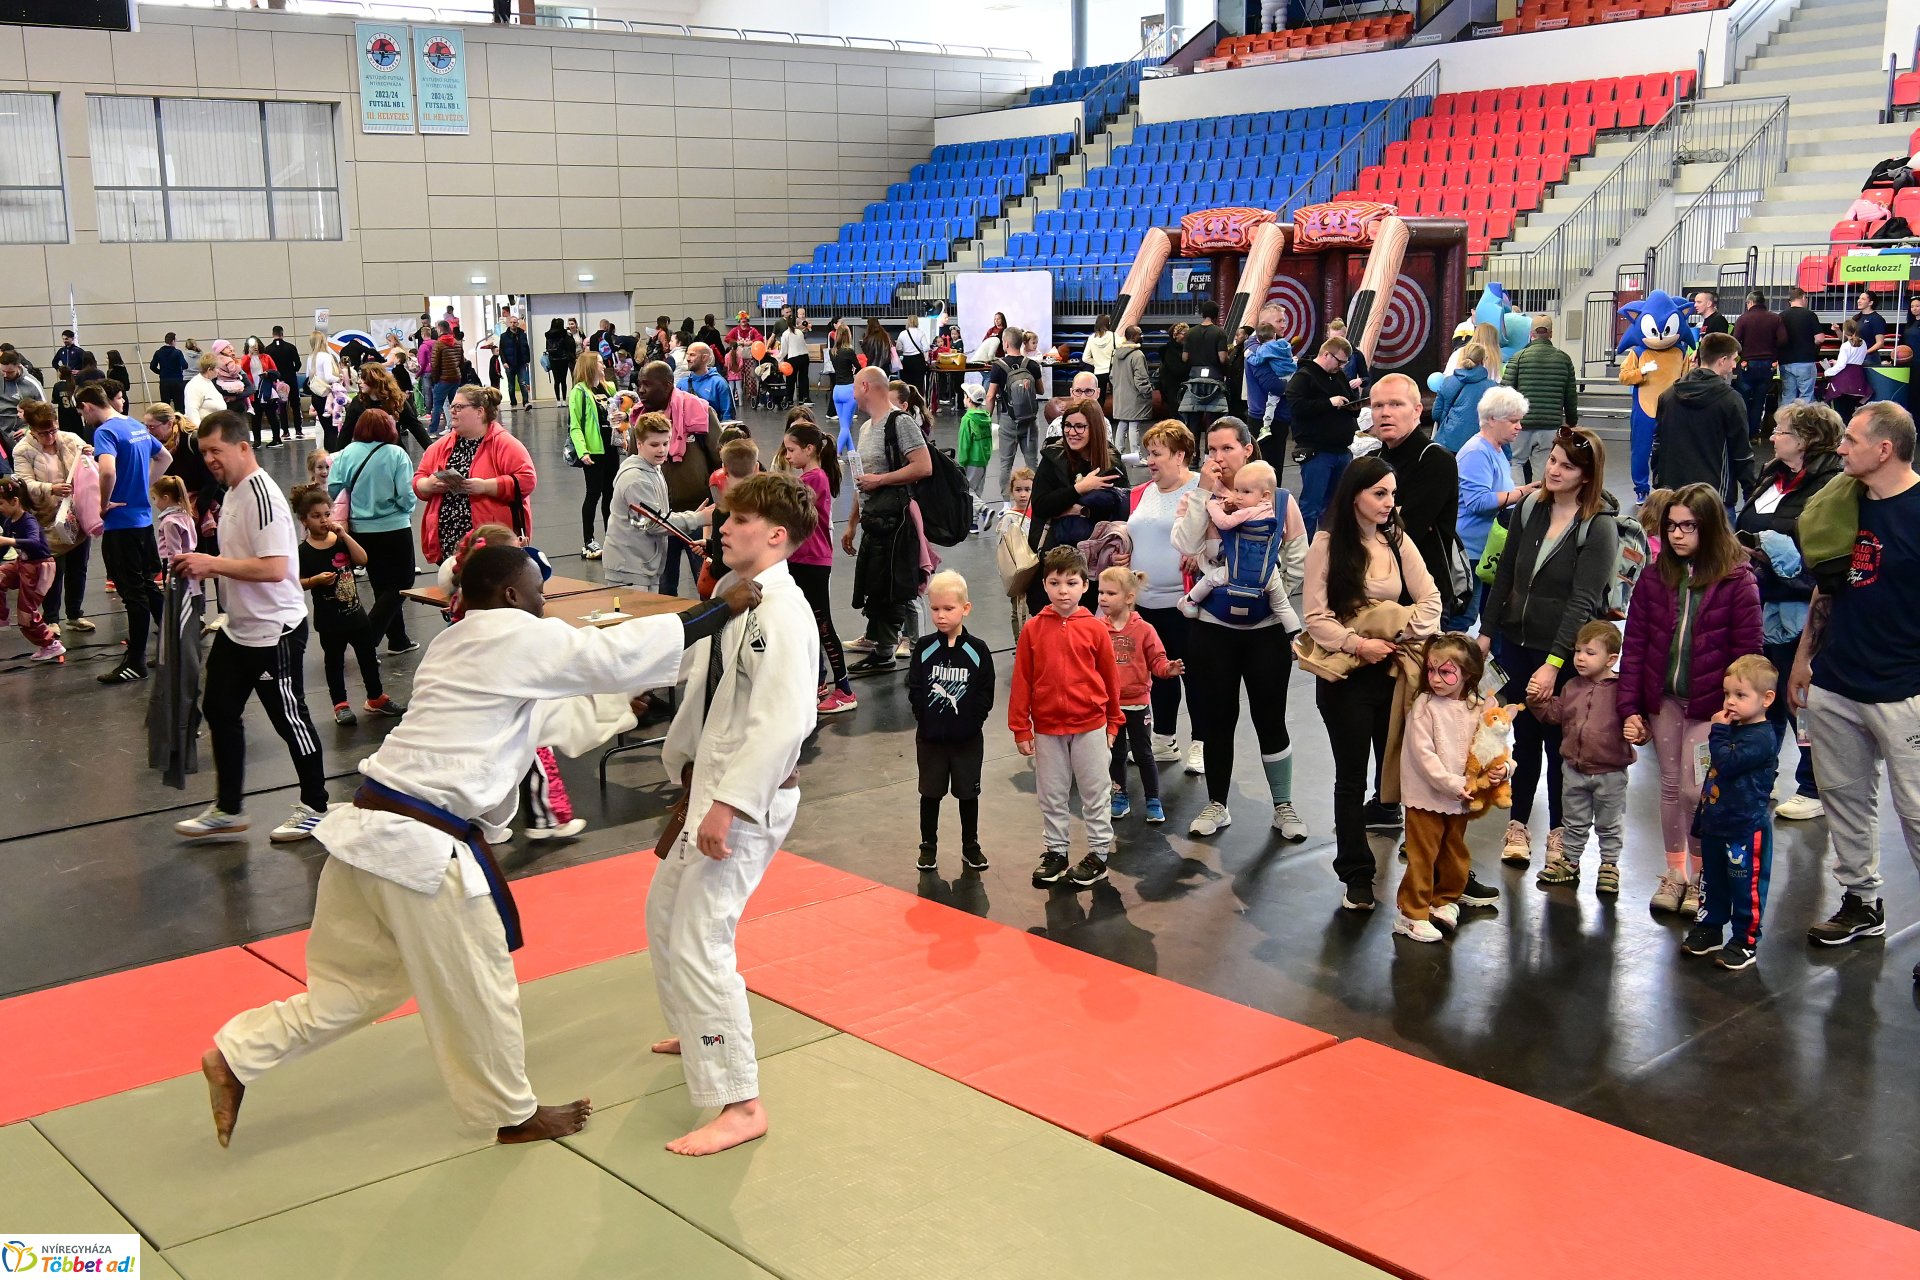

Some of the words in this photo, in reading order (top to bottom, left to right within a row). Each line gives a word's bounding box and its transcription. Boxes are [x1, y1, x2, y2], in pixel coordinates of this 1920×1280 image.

[375, 91, 399, 99] 2023/24
[431, 92, 454, 100] 2024/25
[1190, 214, 1243, 240] AXE
[1304, 209, 1362, 234] AXE
[1845, 263, 1902, 273] Csatlakozz!
[931, 665, 969, 682] PUMA
